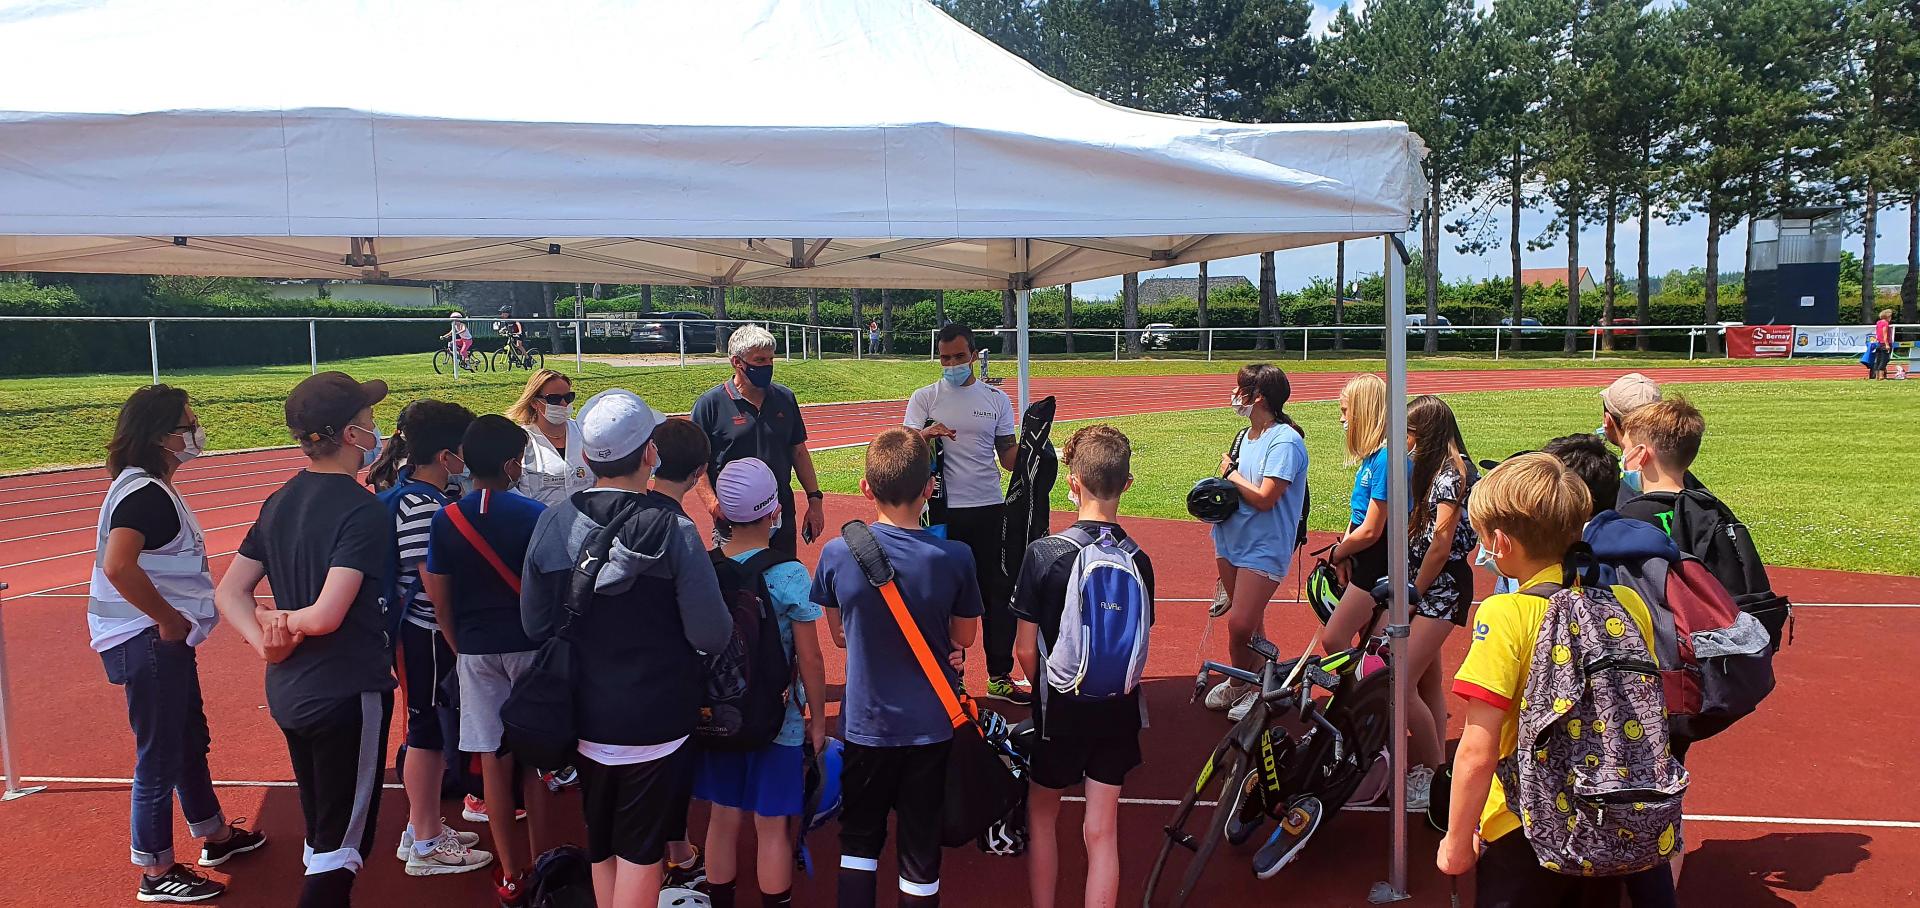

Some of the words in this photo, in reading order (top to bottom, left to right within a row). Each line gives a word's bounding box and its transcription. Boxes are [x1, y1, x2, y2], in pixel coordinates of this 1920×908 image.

[1816, 335, 1859, 347] BERNAY
[753, 493, 775, 511] arena
[1261, 729, 1280, 791] SCOTT
